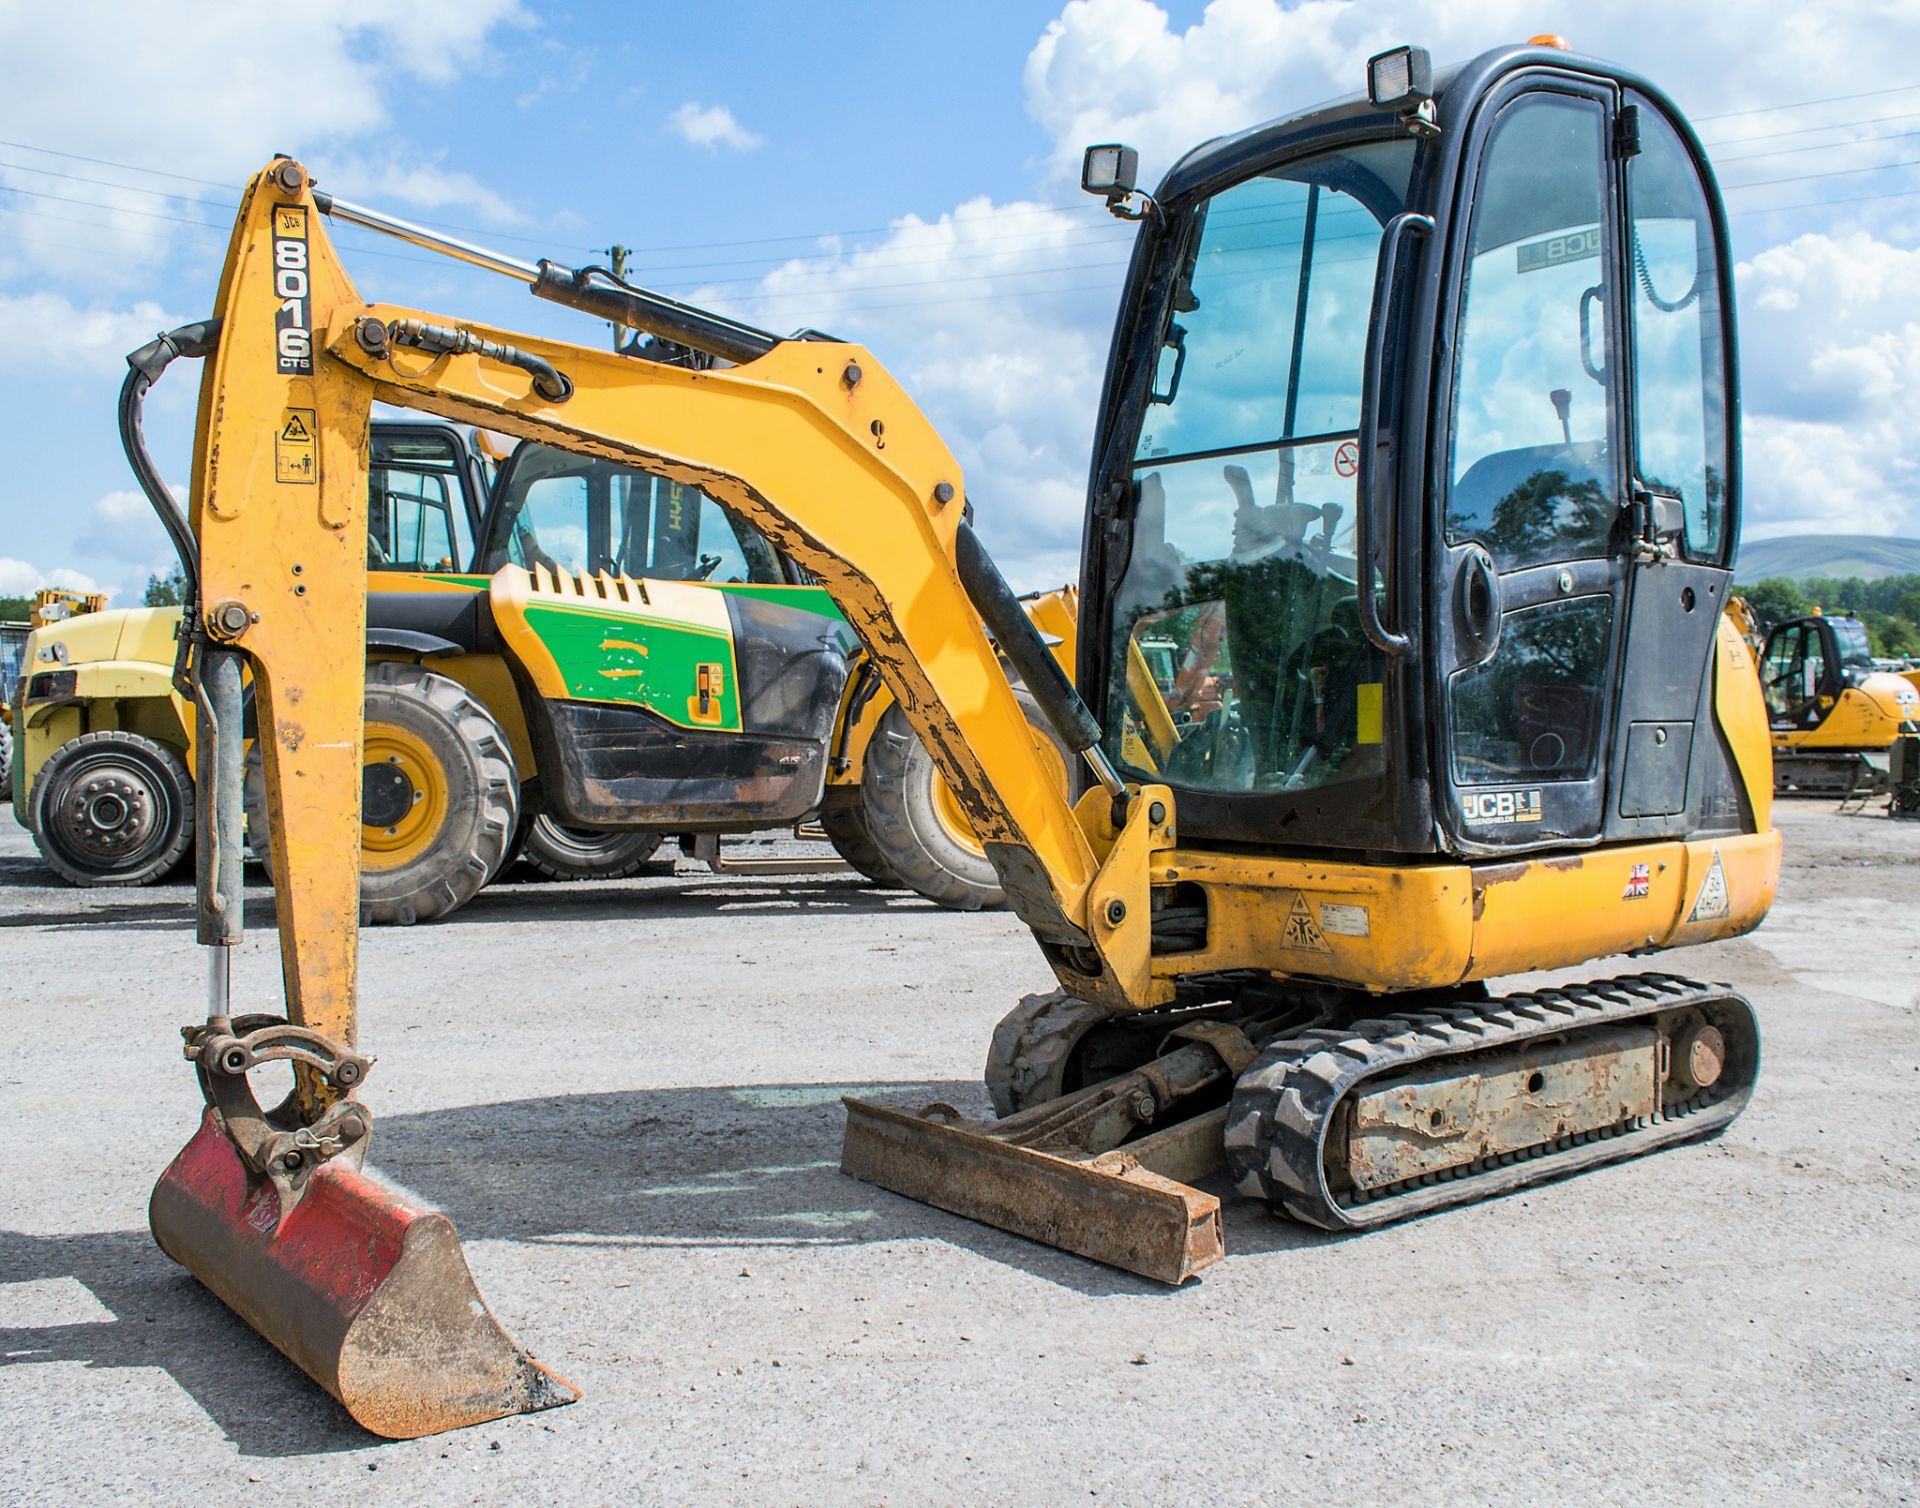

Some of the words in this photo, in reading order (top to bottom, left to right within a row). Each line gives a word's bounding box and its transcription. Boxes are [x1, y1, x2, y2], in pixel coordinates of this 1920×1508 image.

[283, 215, 300, 229] JCB
[276, 240, 310, 358] 8016
[280, 358, 310, 369] CTS
[1463, 792, 1515, 819] JCB
